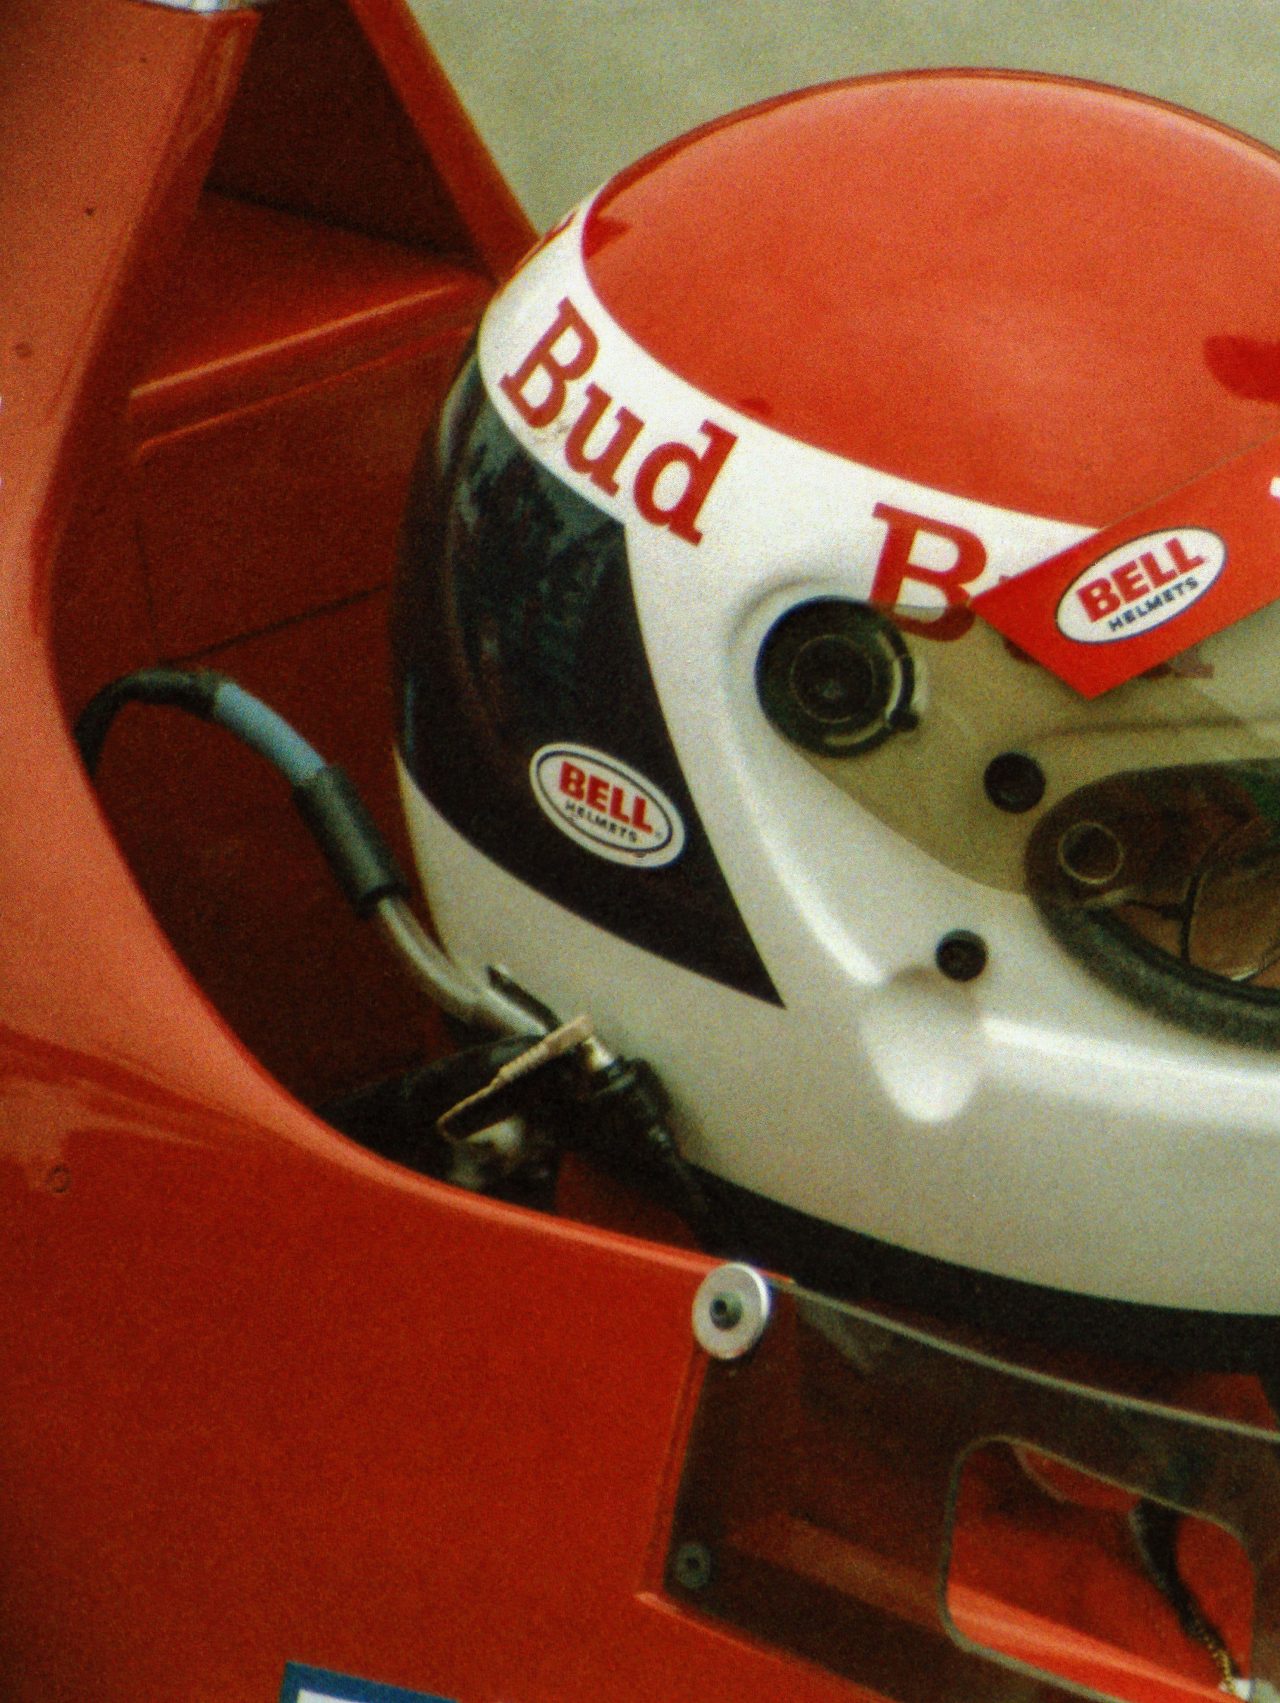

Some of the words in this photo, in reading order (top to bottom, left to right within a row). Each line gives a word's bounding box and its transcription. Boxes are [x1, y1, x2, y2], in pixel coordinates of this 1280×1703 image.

[499, 296, 739, 547] Bud
[1076, 537, 1206, 623] BELL
[1108, 576, 1199, 632] HELMETS
[559, 761, 653, 834] BELL
[564, 800, 638, 844] HELMETS
